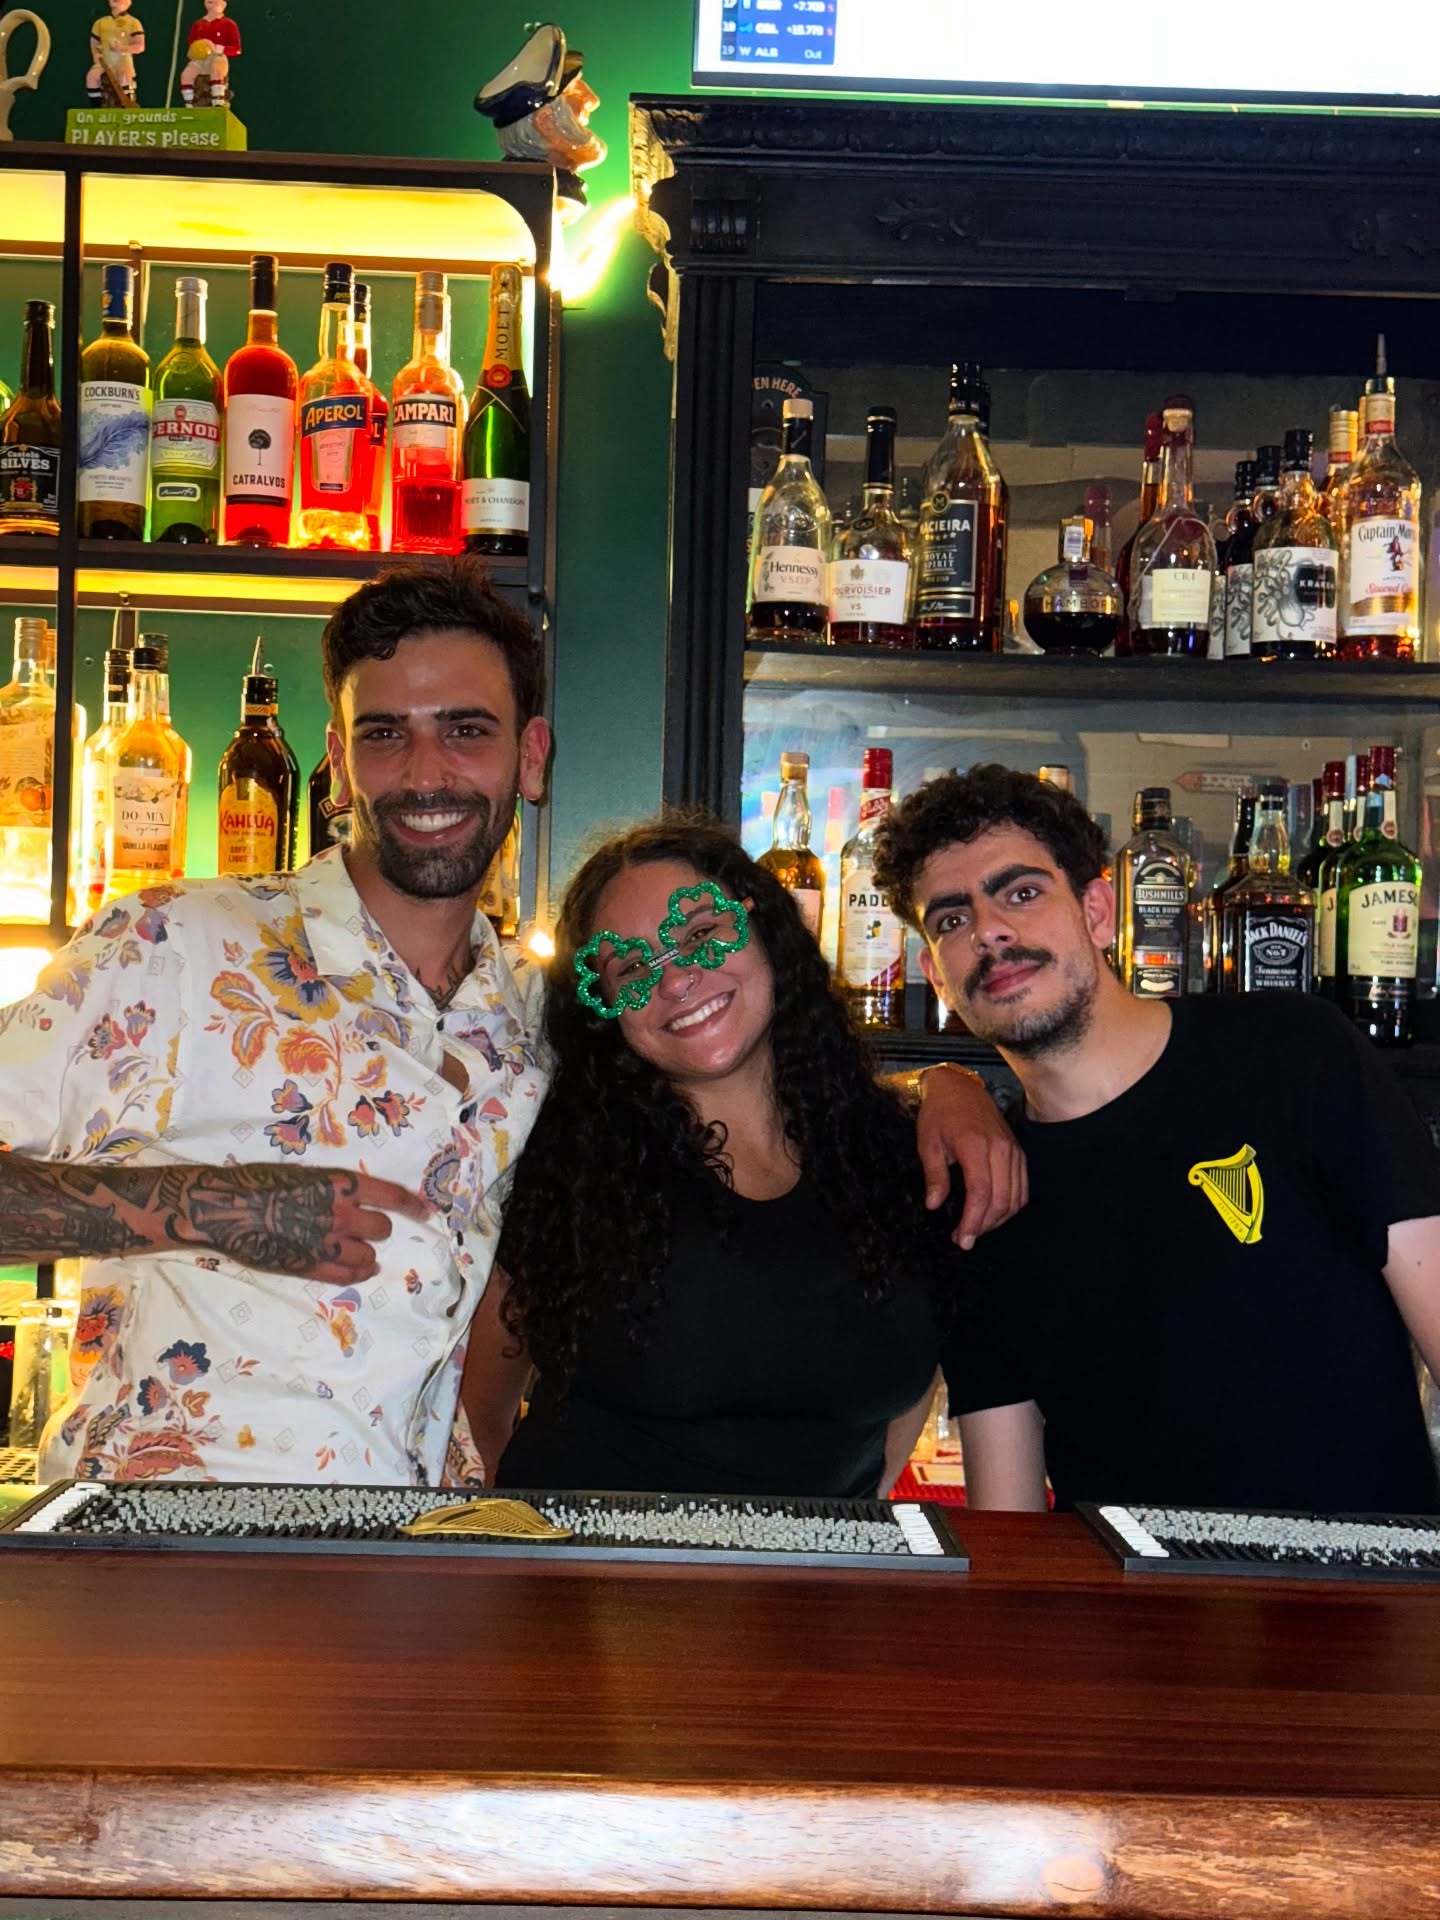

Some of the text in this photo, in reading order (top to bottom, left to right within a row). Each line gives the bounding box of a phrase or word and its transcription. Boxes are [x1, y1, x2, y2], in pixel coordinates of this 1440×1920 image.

[721, 45, 735, 55] 19
[755, 47, 778, 57] ALB
[76, 111, 94, 123] On
[123, 111, 177, 125] grounds
[71, 129, 220, 148] PLAYER'S please
[84, 386, 140, 400] COCKBURN'S
[771, 376, 803, 399] HERE
[304, 404, 363, 430] APEROL
[0, 458, 51, 470] SILVES
[232, 474, 286, 489] CATRALVOS
[488, 496, 525, 506] CHANDON
[1358, 524, 1396, 543] Captain
[770, 561, 818, 578] Hennessy
[220, 809, 275, 838] KAHLÚA
[1135, 888, 1185, 900] BUSHMILLS
[1138, 906, 1160, 914] BLACK
